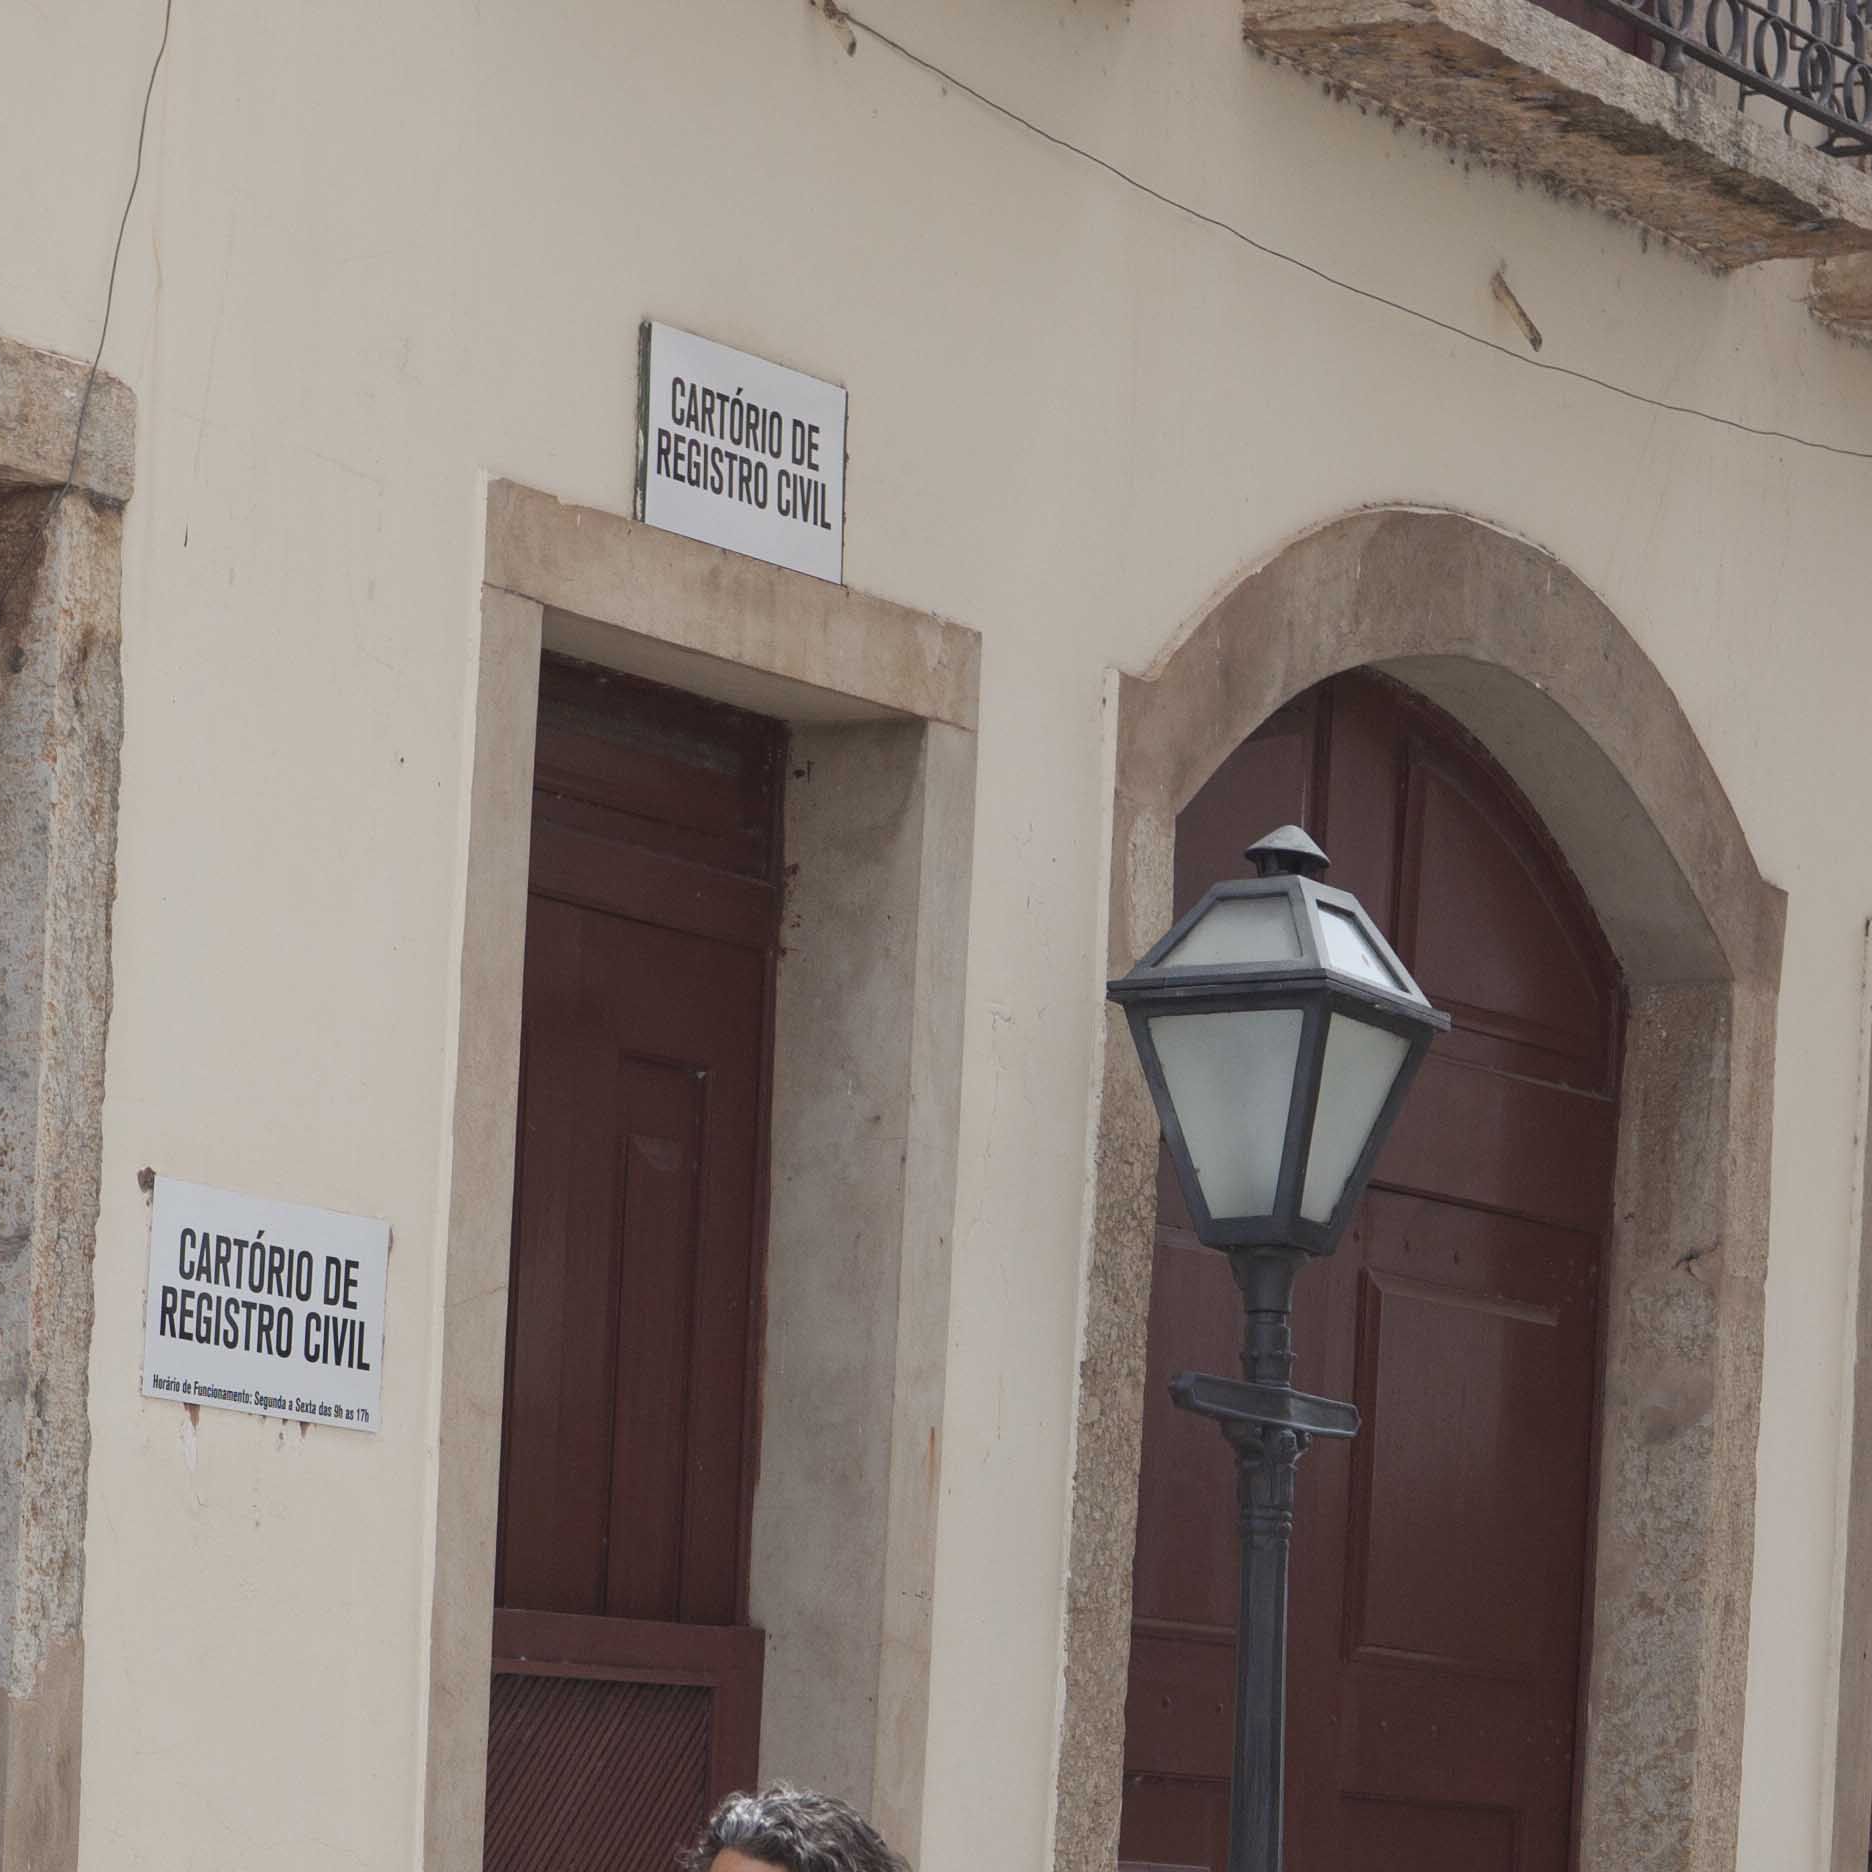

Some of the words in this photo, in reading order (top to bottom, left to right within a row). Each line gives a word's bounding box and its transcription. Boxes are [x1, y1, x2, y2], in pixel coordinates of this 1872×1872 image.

[671, 377, 783, 459] CARTÓRIO
[791, 419, 821, 472] DE
[656, 428, 769, 510] REGISTRO
[777, 469, 831, 530] CIVIL
[179, 1228, 314, 1302] CARTÓRIO
[323, 1256, 360, 1310] DE
[159, 1285, 294, 1359] REGISTRO
[303, 1312, 371, 1372] CIVIL
[152, 1373, 181, 1393] Horário
[182, 1379, 192, 1395] de
[193, 1381, 253, 1406] Funcionamento:
[254, 1390, 287, 1411] Segunda
[295, 1397, 317, 1415] Sexta
[318, 1400, 333, 1418] das
[333, 1404, 344, 1419] 9h
[356, 1407, 370, 1424] 17h
